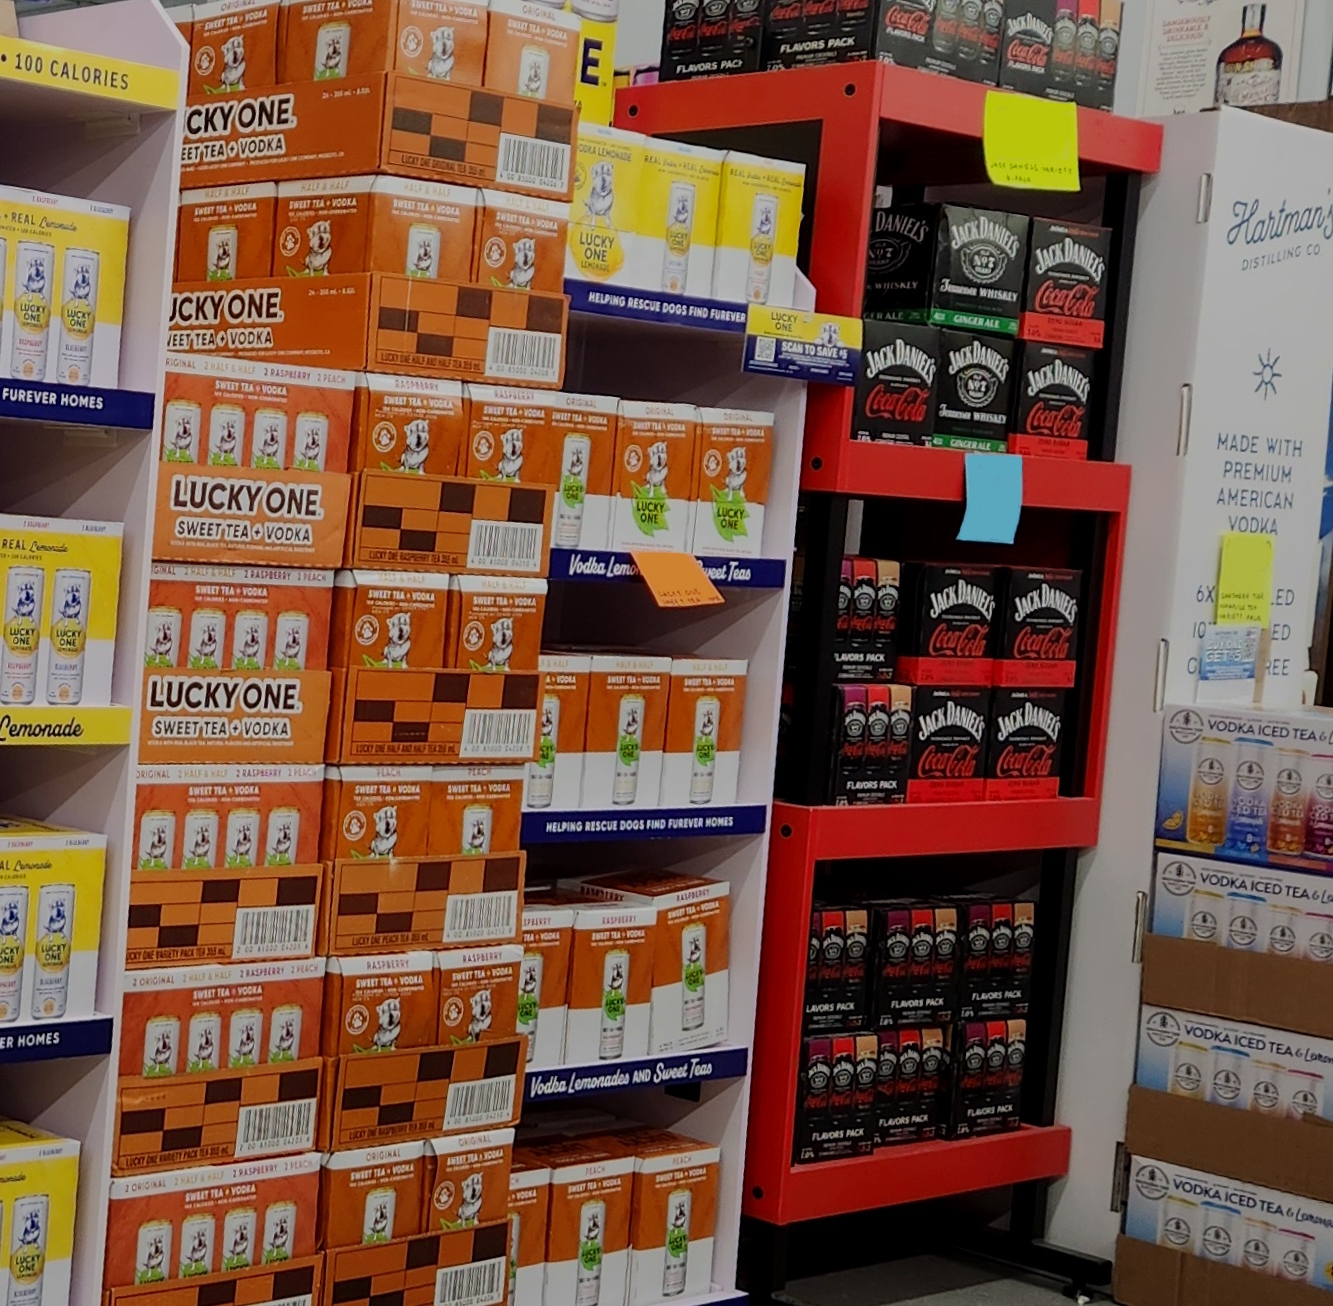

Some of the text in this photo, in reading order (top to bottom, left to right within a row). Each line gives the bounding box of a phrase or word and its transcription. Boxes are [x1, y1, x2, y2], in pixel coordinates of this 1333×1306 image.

[780, 36, 855, 53] FLAVORS PACK
[15, 52, 44, 74] 100
[50, 59, 129, 90] CALORIES
[237, 97, 291, 128] ONE
[10, 212, 36, 226] REAL
[40, 216, 78, 232] Lemonade
[580, 233, 614, 249] LUCKY
[951, 216, 1020, 260] JACK DANIEL'S
[584, 247, 607, 262] ONE
[1035, 237, 1106, 285] JACK DANIEL'S
[1241, 243, 1321, 271] DISTILLING CO
[227, 291, 280, 320] ONE
[979, 288, 1018, 303] WHISKEY
[589, 291, 746, 323] HELPING RESCUE DOGS FIND FUREVER
[771, 312, 798, 324] LUCKY
[775, 322, 793, 332] ONE
[782, 341, 803, 354] SCAN
[805, 345, 815, 355] TO
[817, 346, 837, 358] SAVE
[1027, 359, 1091, 402] JACK DANIEL'S
[2, 387, 57, 406] FUREVER
[60, 392, 104, 410] HOMES
[973, 409, 1007, 425] WHISKEY
[1217, 433, 1303, 458] MADE WITH
[1223, 460, 1293, 483] PREMIUM
[173, 478, 321, 516] LUCKY ONE
[636, 501, 664, 512] LUCKY
[1216, 487, 1294, 510] AMERICAN
[640, 513, 659, 524] ONE
[721, 519, 738, 530] ONE
[1228, 515, 1279, 535] VODKA
[177, 522, 311, 542] SWEET TEA VODKA
[569, 553, 606, 575] Vodka
[693, 560, 751, 581] weet Teas
[930, 579, 996, 622] JACK DANIEL'S
[1196, 585, 1216, 603] 6X
[154, 720, 290, 737] SWEET TEA VODKA
[1208, 719, 1317, 742] VODKA ICED TEA
[376, 767, 402, 779] PEACH
[847, 780, 897, 790] FLAVORS PACK
[546, 816, 734, 833] HELPING RESCUE DOGS FIND FUREVER HOMES
[1201, 872, 1310, 900] VODKA ICED TEA
[367, 958, 409, 971] RASPBERRY
[140, 963, 319, 987] ORIGINAL RASPBERRY PEACH
[17, 1032, 61, 1049] HOMES
[530, 1057, 713, 1098] Vodka Lemonades AND Sweet Teas
[812, 1127, 865, 1141] FLAVORS PACK
[366, 1149, 402, 1161] ORIGINAL
[1174, 1178, 1285, 1216] VODKA ICED TEA
